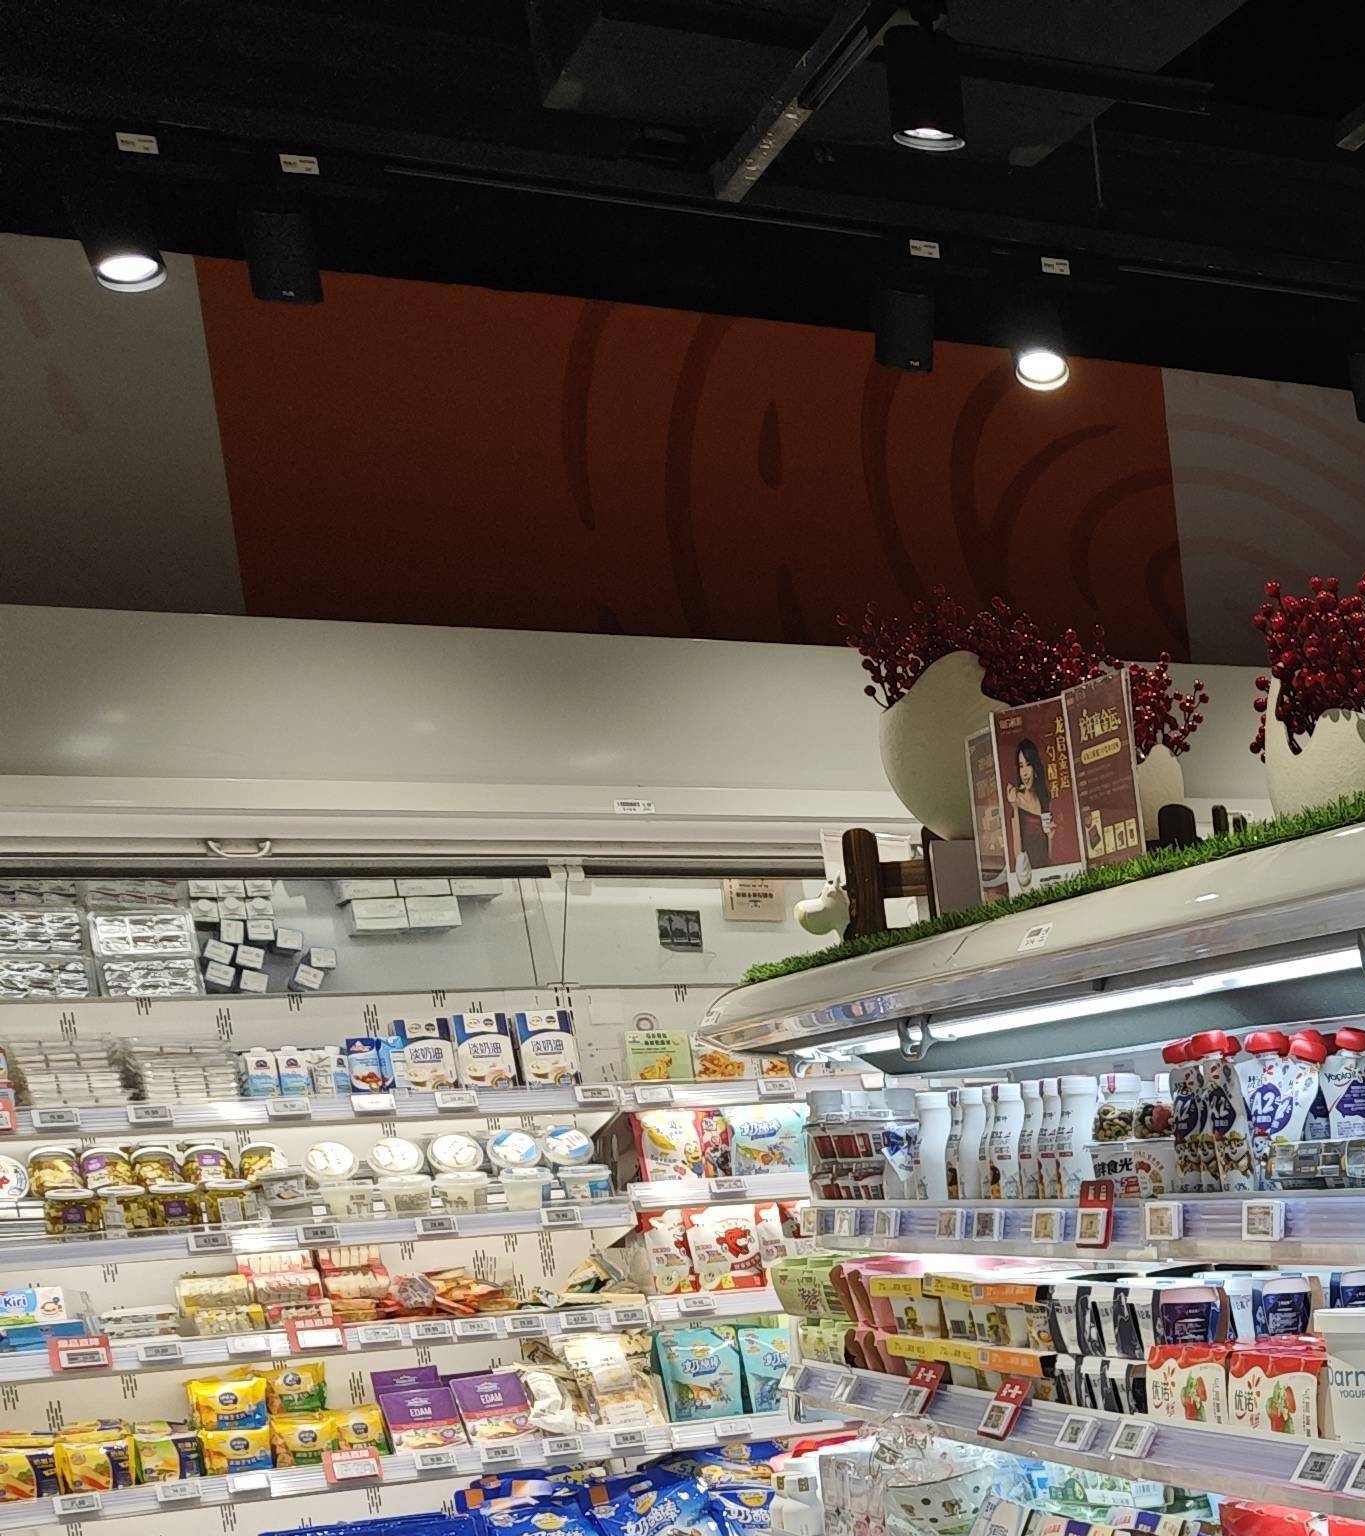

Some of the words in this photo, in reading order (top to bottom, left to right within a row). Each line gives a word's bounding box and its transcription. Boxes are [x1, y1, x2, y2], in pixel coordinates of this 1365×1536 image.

[3, 1294, 28, 1309] Kiri
[480, 1393, 503, 1404] EDAM
[409, 1407, 433, 1418] EDAM
